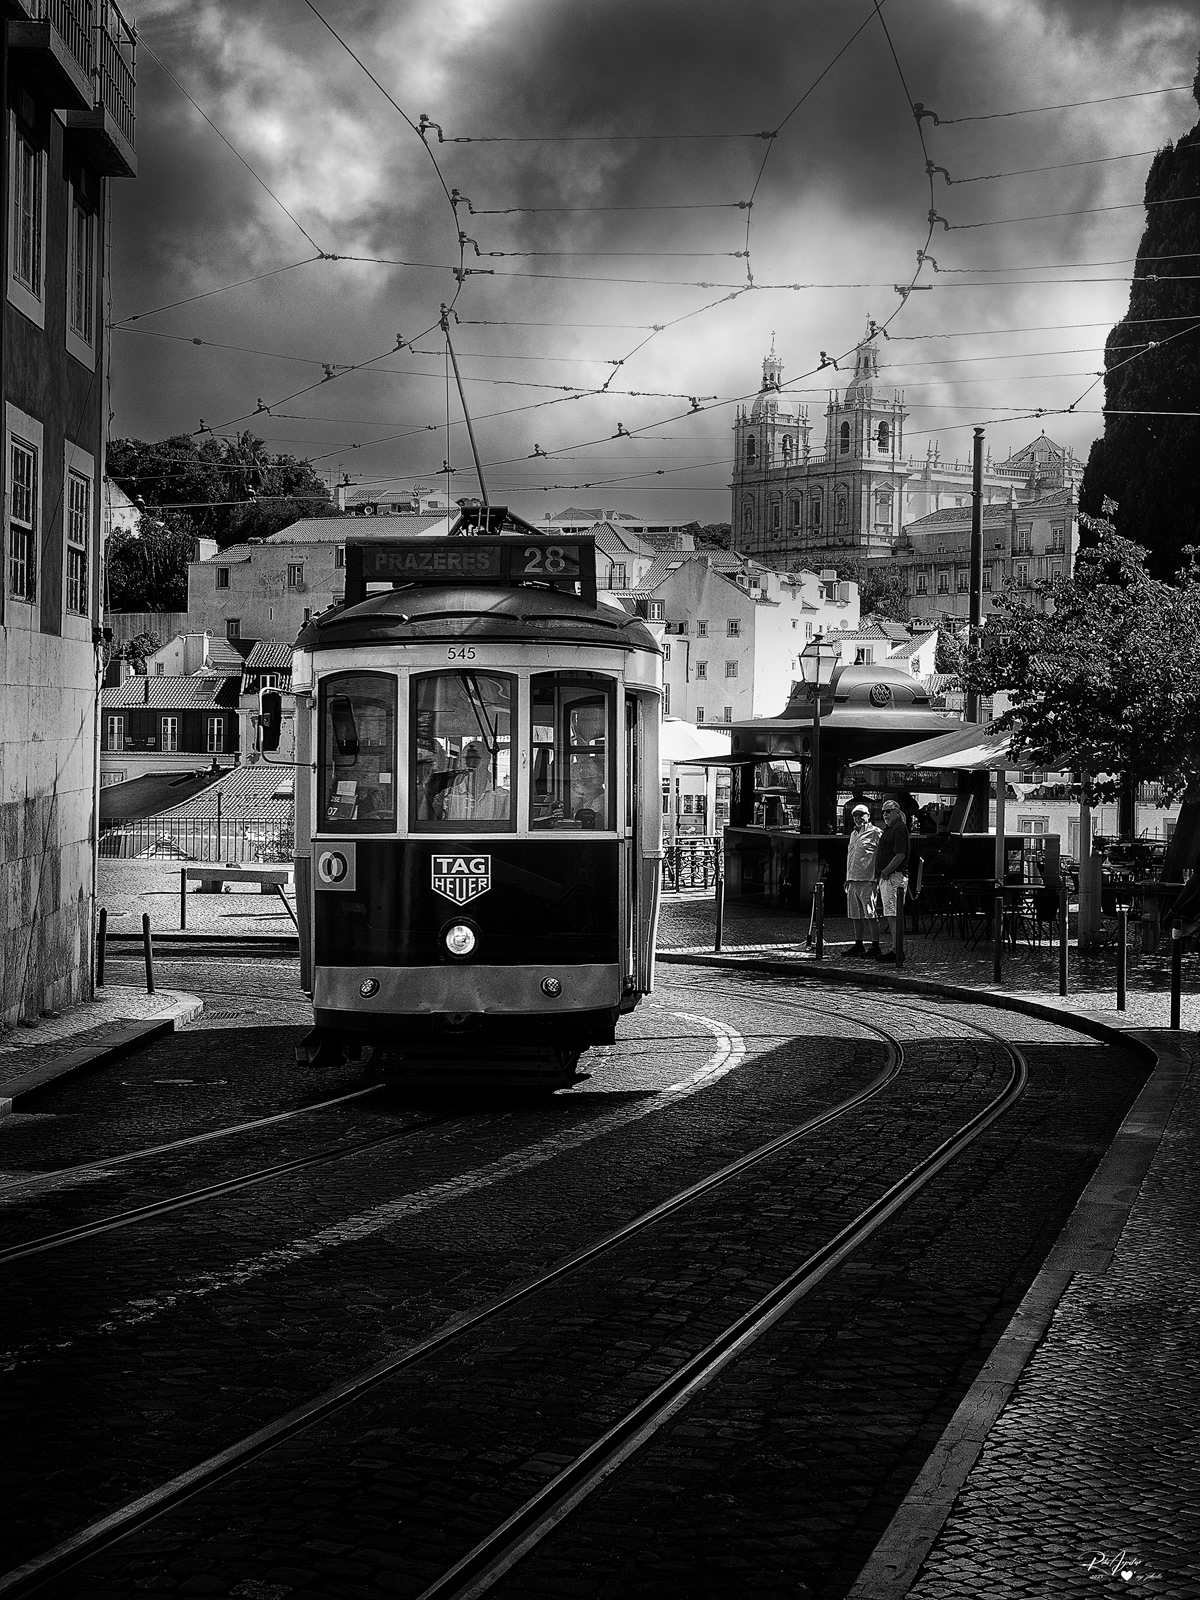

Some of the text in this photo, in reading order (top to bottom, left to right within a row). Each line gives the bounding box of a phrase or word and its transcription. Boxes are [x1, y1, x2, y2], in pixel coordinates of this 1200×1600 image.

[374, 546, 566, 573] PRAZERES 28
[447, 646, 477, 660] 545
[327, 806, 338, 816] 07
[436, 858, 486, 874] TAG
[434, 878, 487, 902] HEUER
